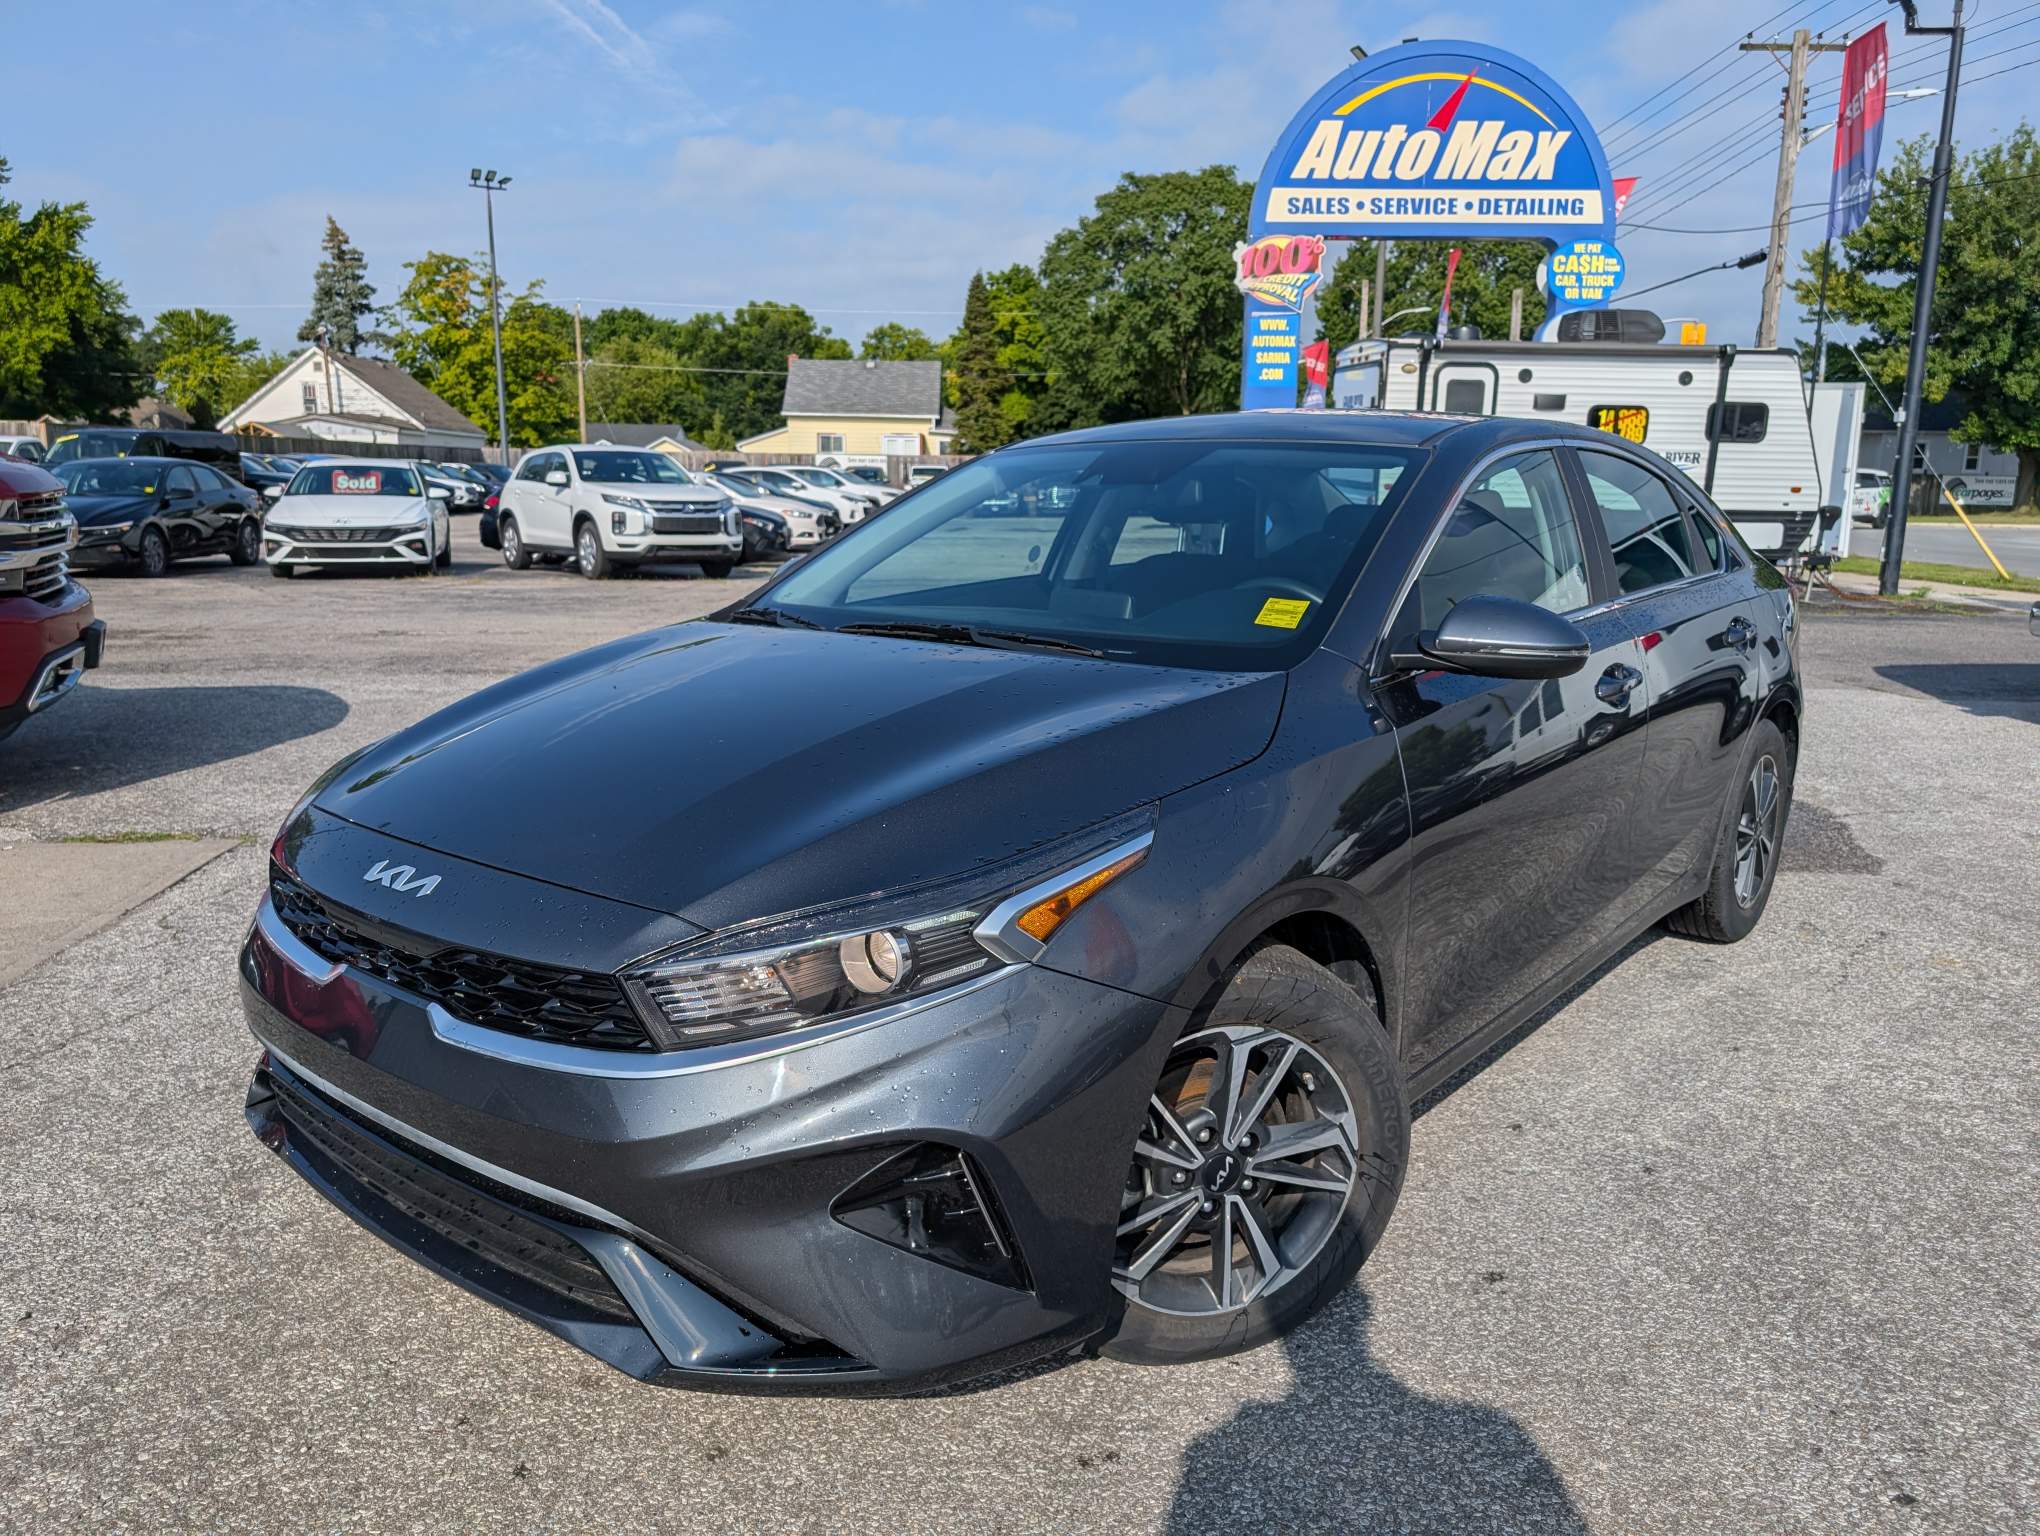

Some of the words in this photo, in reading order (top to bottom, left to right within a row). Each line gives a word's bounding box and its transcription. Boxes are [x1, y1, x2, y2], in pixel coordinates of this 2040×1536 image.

[1290, 119, 1571, 181] AutoMax
[1287, 196, 1349, 215] SALES
[1370, 197, 1458, 215] SERVICE
[1477, 198, 1584, 216] DETAILING
[1240, 236, 1324, 278] 100%
[1263, 272, 1311, 288] CREDIT
[1582, 275, 1615, 287] TRUCK
[1248, 282, 1300, 303] ROVAL
[1565, 288, 1579, 299] OR
[1582, 288, 1603, 299] VAN
[1252, 336, 1296, 347] AUTOMAX
[1256, 352, 1290, 364] SARNIA
[1259, 368, 1283, 380] .COM
[1665, 452, 1701, 464] RIVER
[337, 475, 377, 489] Sold
